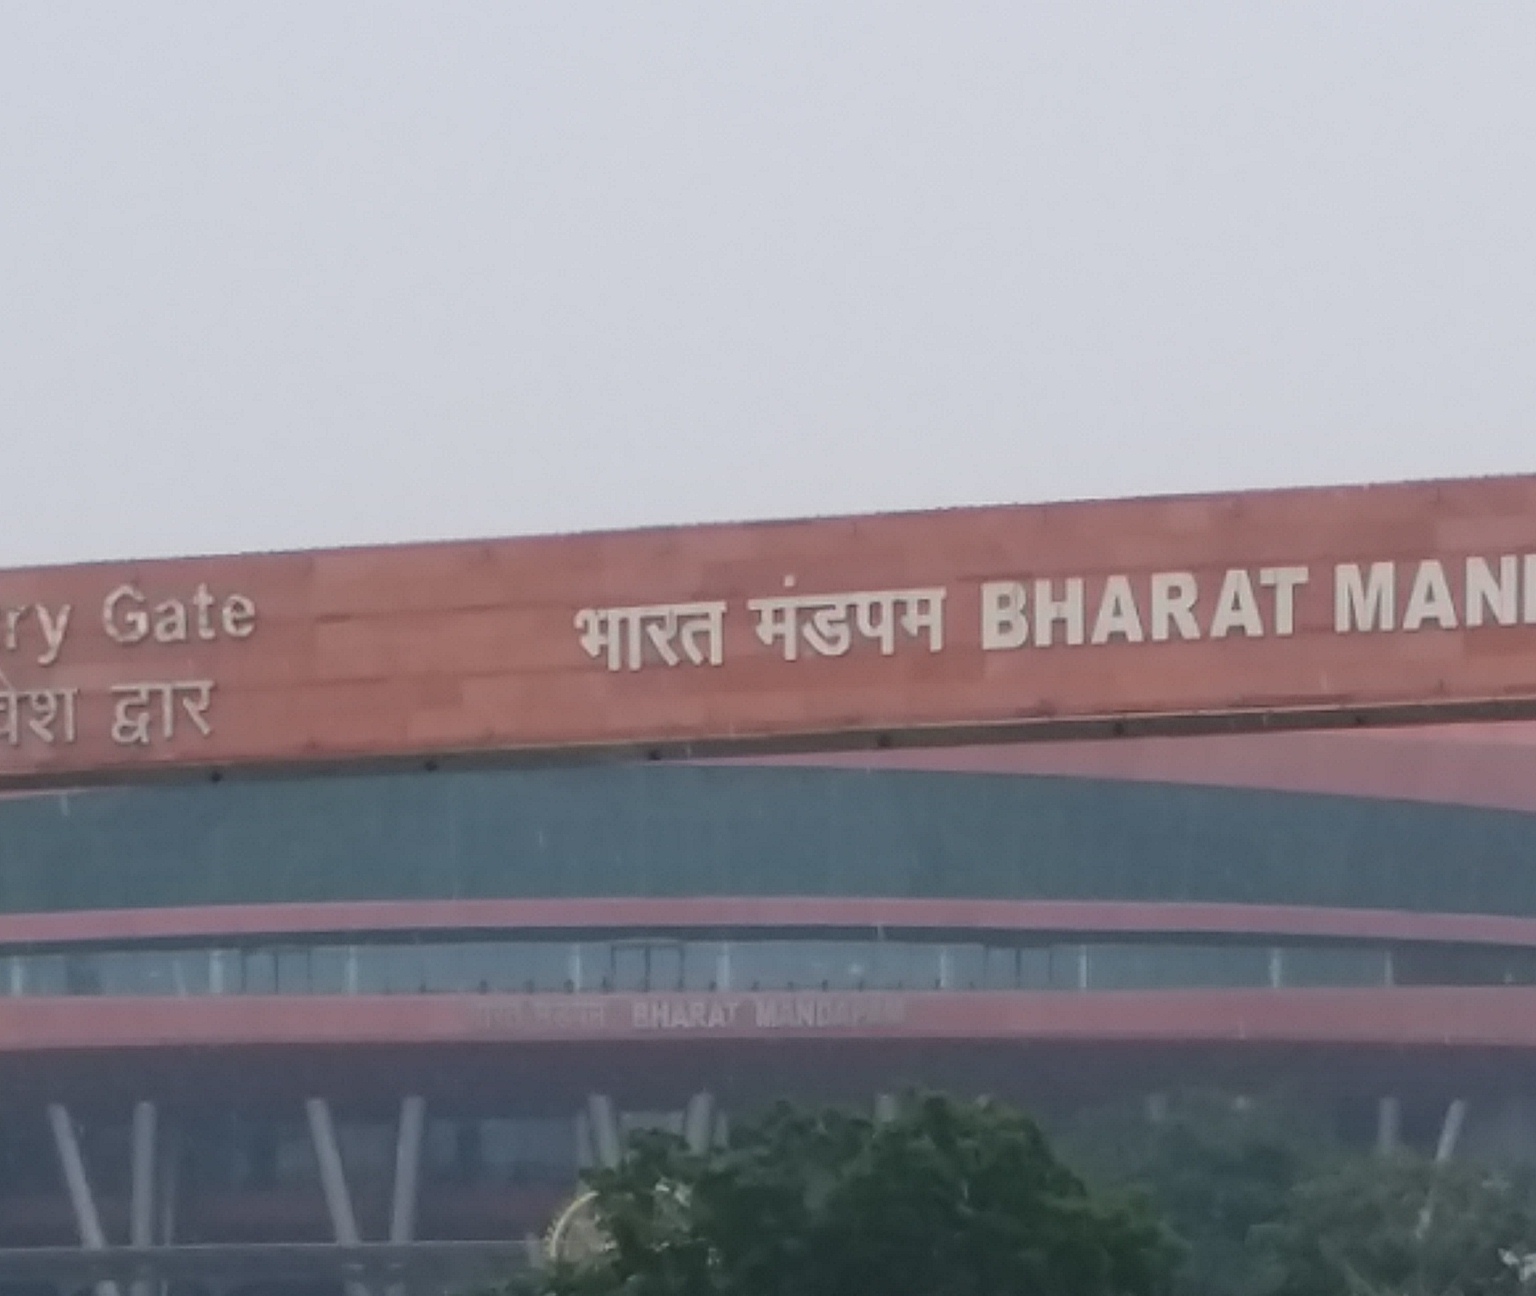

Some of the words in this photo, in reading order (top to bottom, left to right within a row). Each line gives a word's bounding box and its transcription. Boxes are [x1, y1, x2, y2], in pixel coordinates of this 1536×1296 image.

[101, 581, 257, 646] Gate
[573, 599, 727, 673] भारत
[748, 574, 948, 663] मंडपम
[979, 563, 1310, 652] BHARAT
[109, 678, 217, 745] द्वार
[631, 1000, 740, 1030] BHARAT
